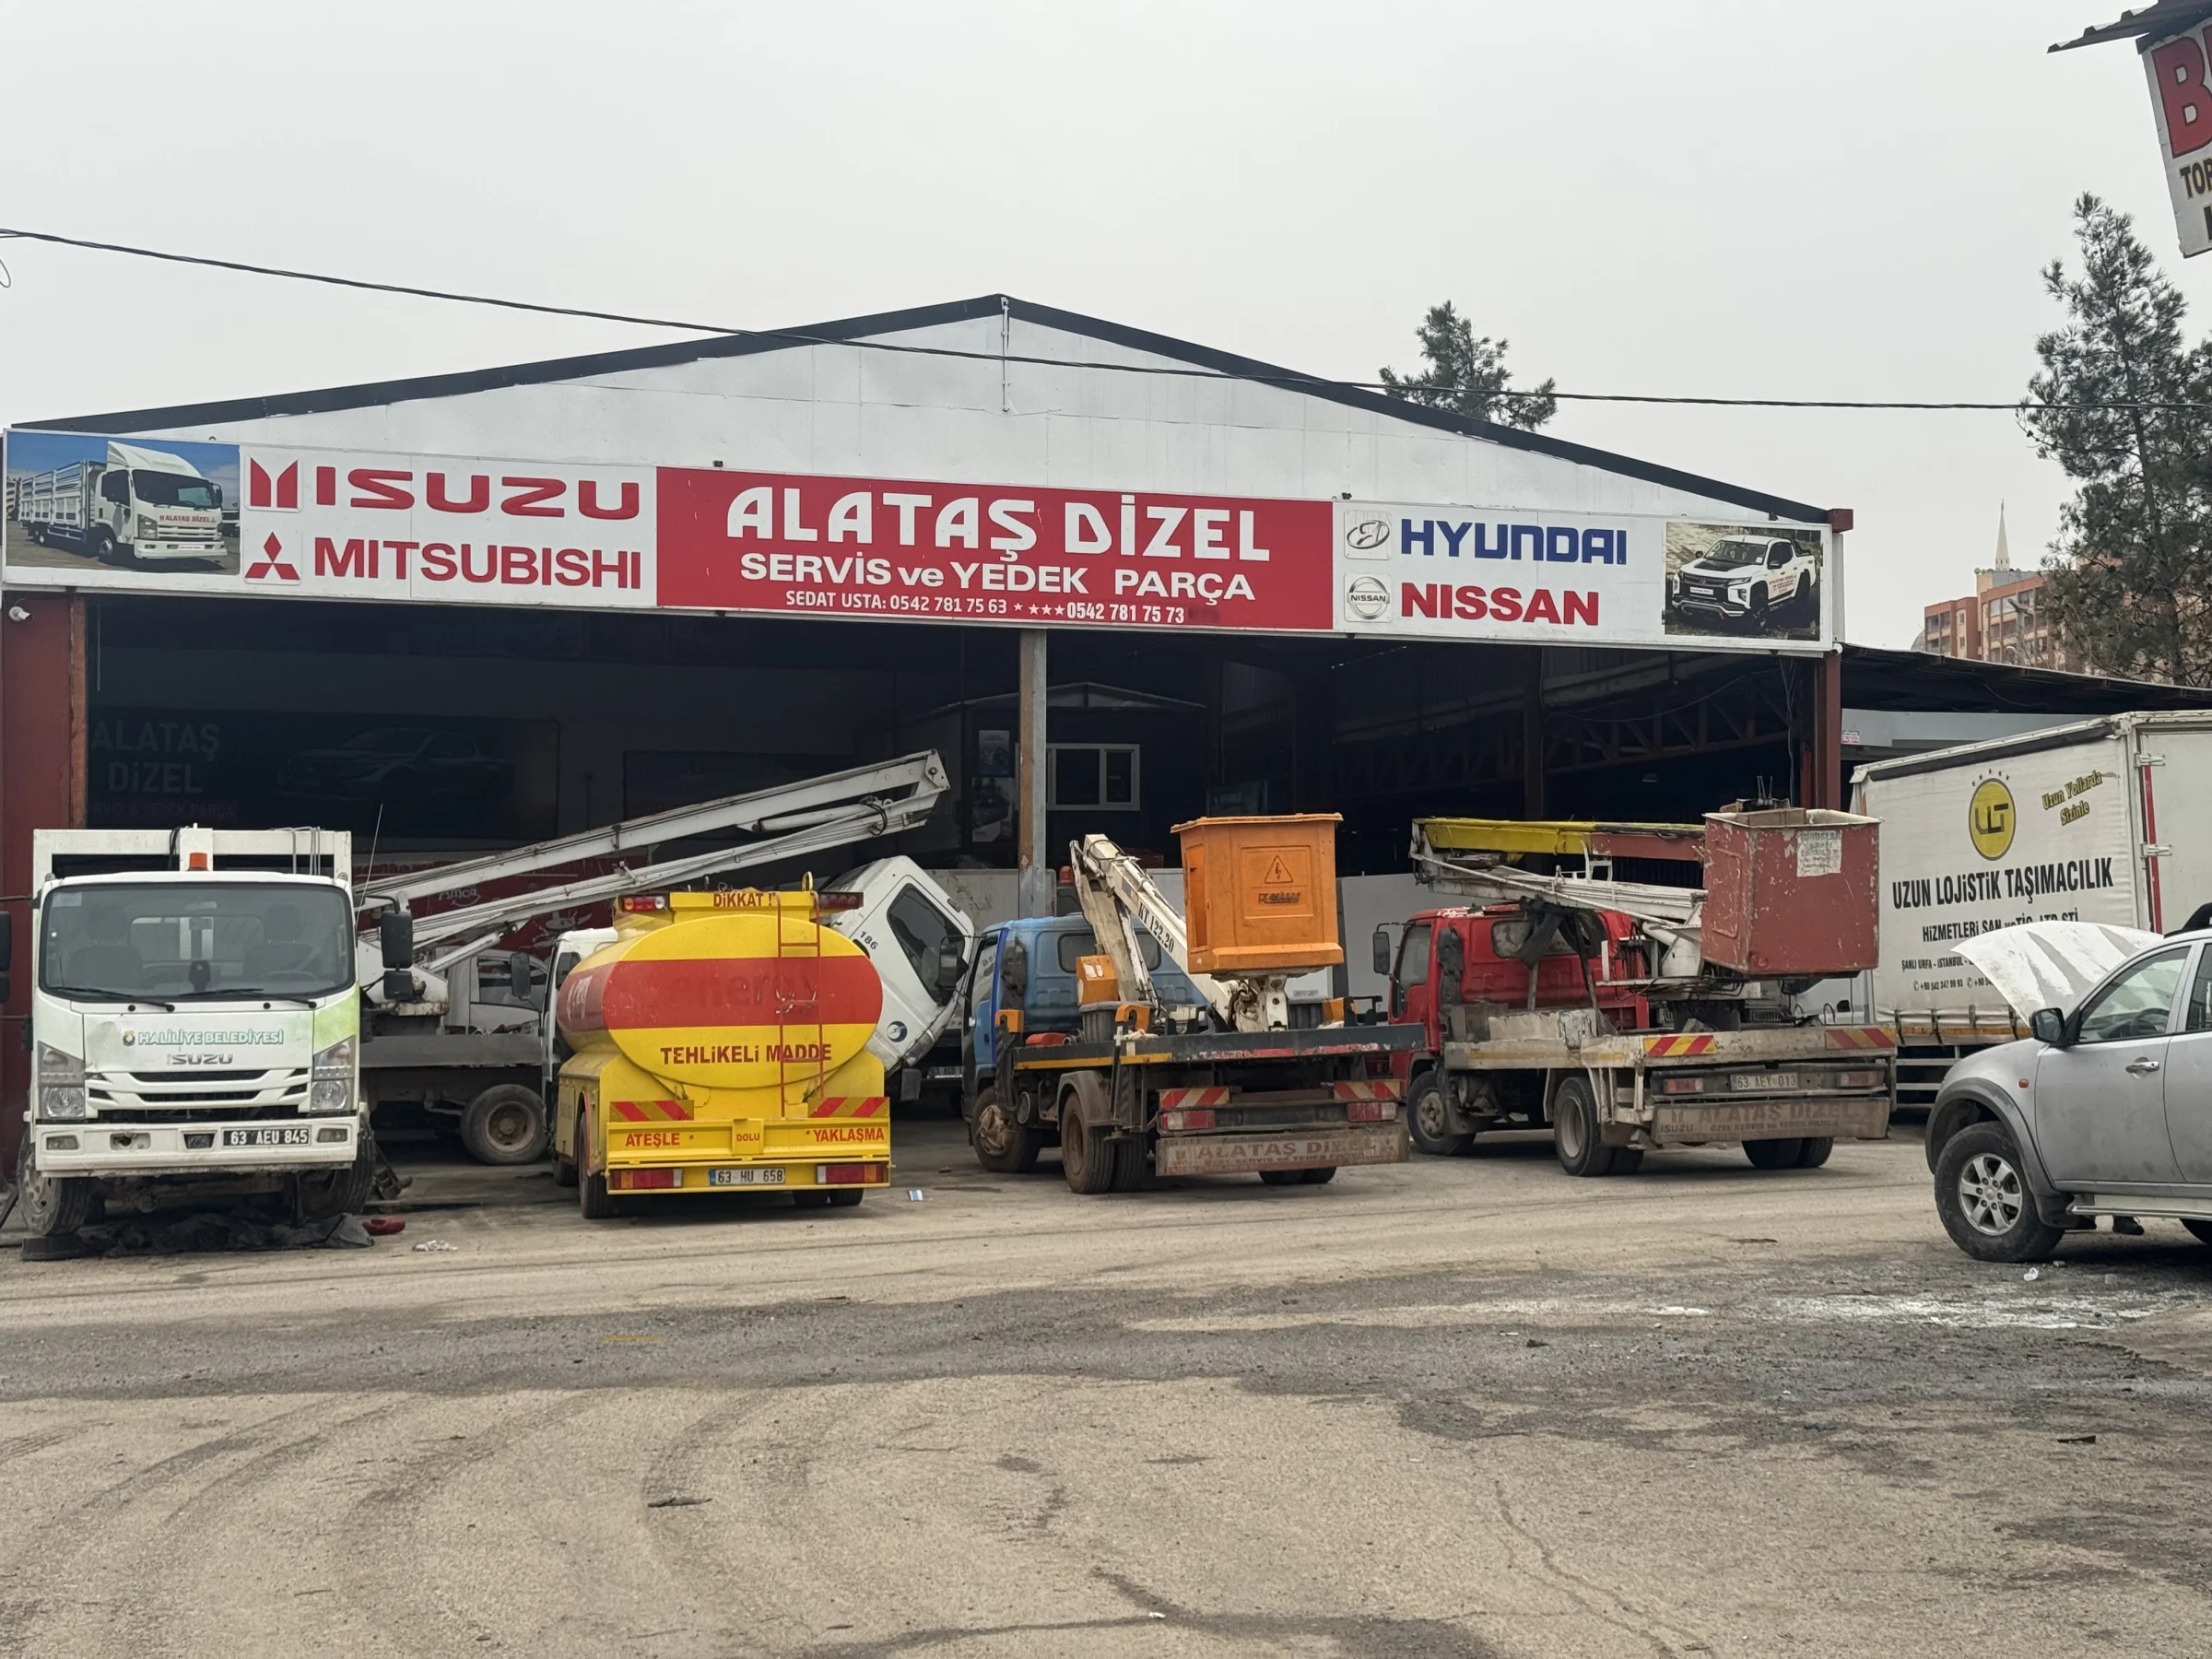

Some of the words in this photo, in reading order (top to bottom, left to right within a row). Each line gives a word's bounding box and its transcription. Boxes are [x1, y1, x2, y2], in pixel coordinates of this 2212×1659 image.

[316, 466, 640, 520] ISUZU
[726, 487, 1037, 562] ALATAŞ
[1065, 495, 1270, 562] DİZEL
[1401, 519, 1627, 565] HYUNDAI
[314, 537, 641, 589] MITSUBISHI
[740, 551, 891, 585] SERVİS
[897, 567, 945, 587] ve
[949, 561, 1089, 594] YEDEK
[1114, 569, 1256, 606] PARÇA
[785, 590, 837, 607] SEDAT
[841, 593, 887, 609] USTA:
[889, 594, 930, 611] 0542
[934, 596, 962, 613] 781
[966, 598, 984, 613] 75
[988, 598, 1007, 614] 63
[1066, 601, 1105, 620] 0542
[1109, 604, 1136, 621] 781
[1142, 606, 1161, 622] 75
[1165, 607, 1185, 624] 73
[1401, 582, 1600, 627] NISSAN
[89, 720, 220, 761] ALATAŞ
[2041, 790, 2065, 810] Uzun
[2065, 770, 2103, 799] Yollarda
[2060, 800, 2090, 826] Sizinle
[1892, 878, 1932, 910] UZUN
[2005, 857, 2114, 904] TAŞIMACILIK
[860, 931, 878, 949] 186
[1149, 915, 1175, 954] 122.20
[138, 1029, 203, 1045] HALİLİYE
[205, 1029, 284, 1045] BELEDİYESİ
[167, 1053, 233, 1065] ISUZU
[766, 1043, 832, 1063] MADDE
[1736, 1076, 1749, 1088] 63
[1755, 1075, 1772, 1088] AEY
[1778, 1074, 1796, 1088] 013
[230, 1131, 248, 1146] 63
[257, 1130, 279, 1145] AEU
[284, 1129, 308, 1144] 845
[625, 1133, 680, 1148] ATEŞLE
[736, 1132, 760, 1143] DOLU
[813, 1127, 885, 1143] YAKLAŞMA
[717, 1170, 732, 1184] 63
[740, 1169, 754, 1183] HU
[763, 1169, 783, 1182] 658
